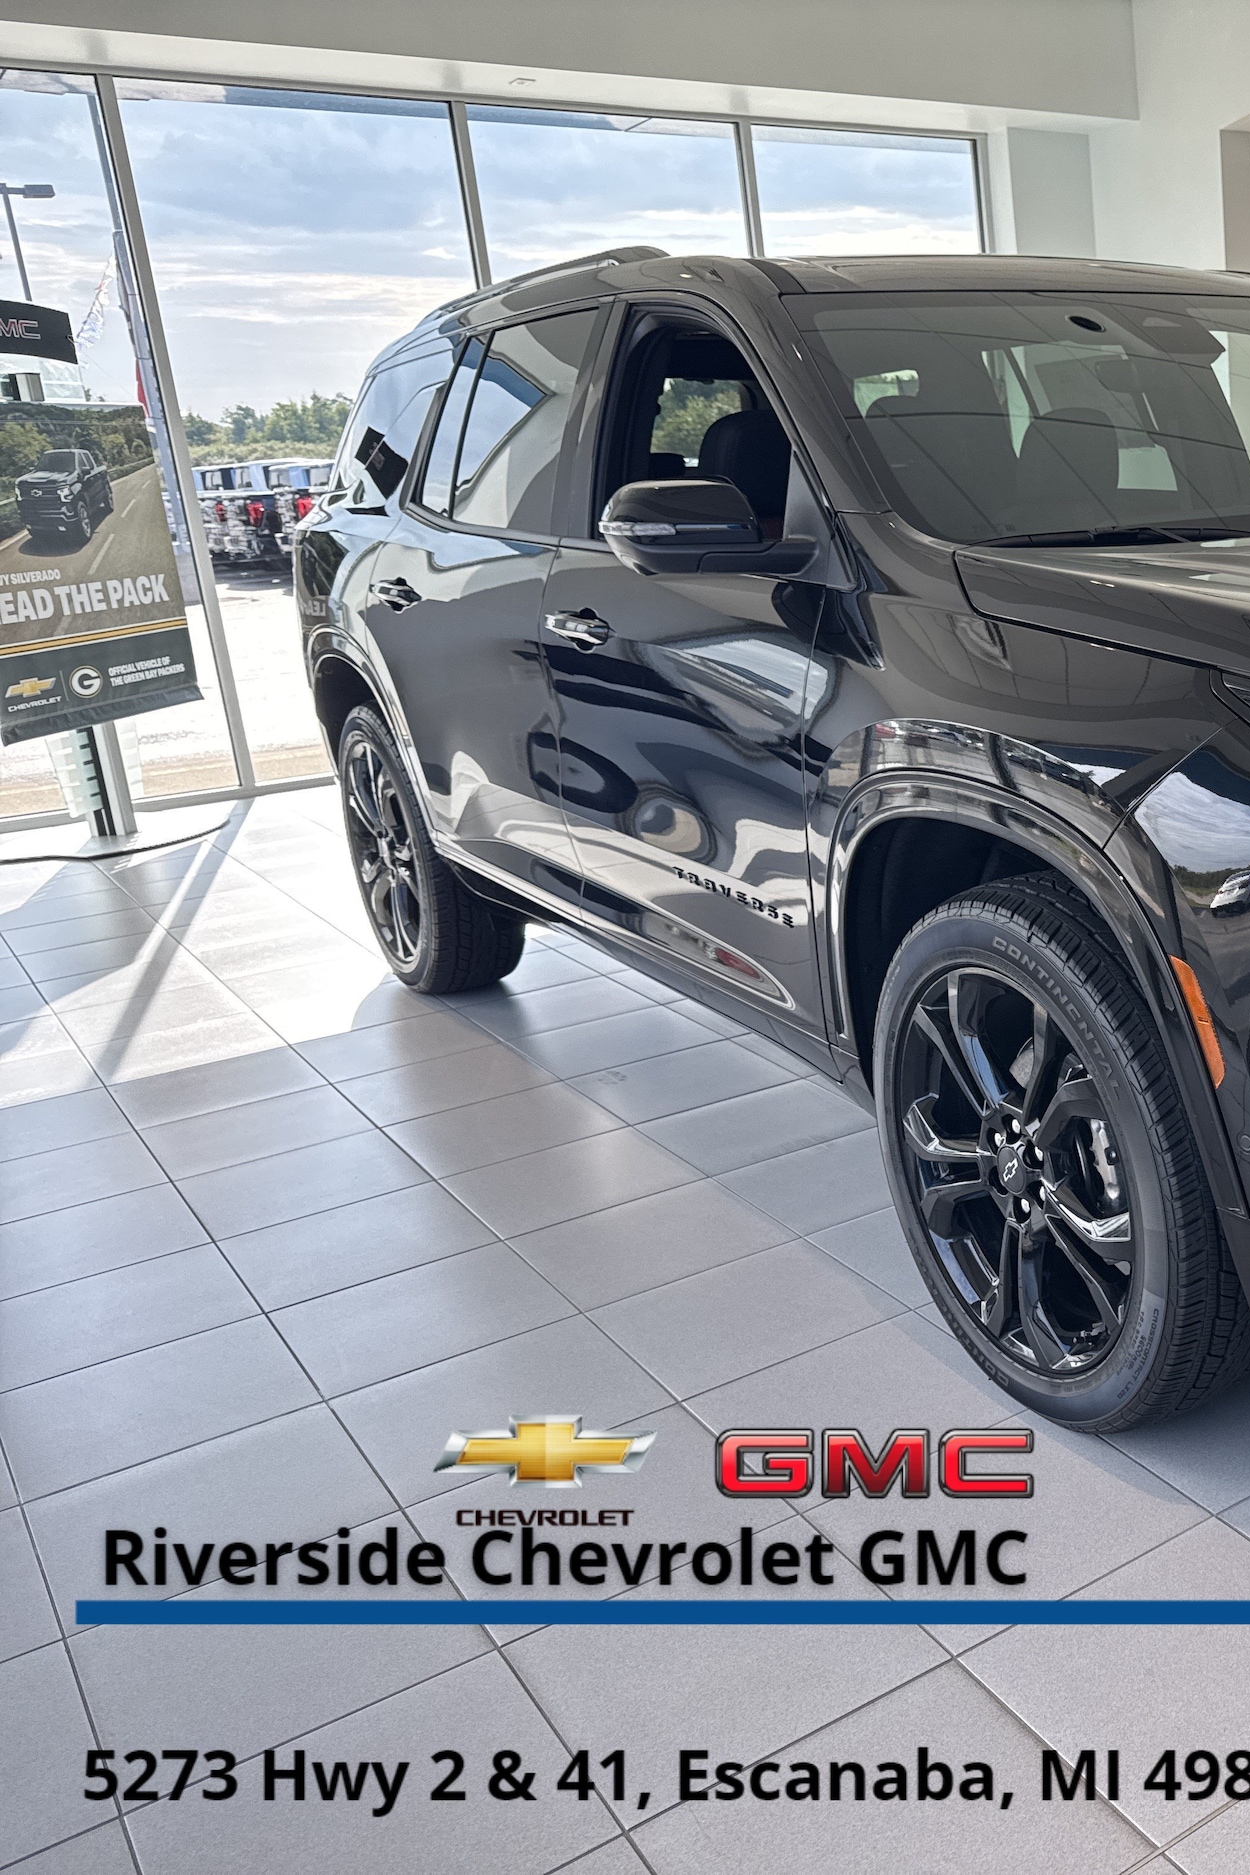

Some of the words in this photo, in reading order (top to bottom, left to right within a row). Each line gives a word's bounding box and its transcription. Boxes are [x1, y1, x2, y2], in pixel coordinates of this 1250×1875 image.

[10, 569, 61, 585] SILVERADO
[0, 588, 54, 625] EAD
[54, 581, 107, 615] THE
[106, 574, 170, 608] PACK
[108, 663, 137, 677] OFFICIAL
[135, 658, 163, 671] VEHICLE
[162, 656, 170, 666] OF
[110, 676, 124, 687] THE
[123, 672, 146, 684] GREEN
[145, 668, 159, 680] BAY
[158, 663, 185, 677] PACKERS
[8, 696, 62, 712] CHEVROLET
[672, 866, 795, 928] TRAVERSE
[992, 936, 1120, 1101] CONTINENTAL
